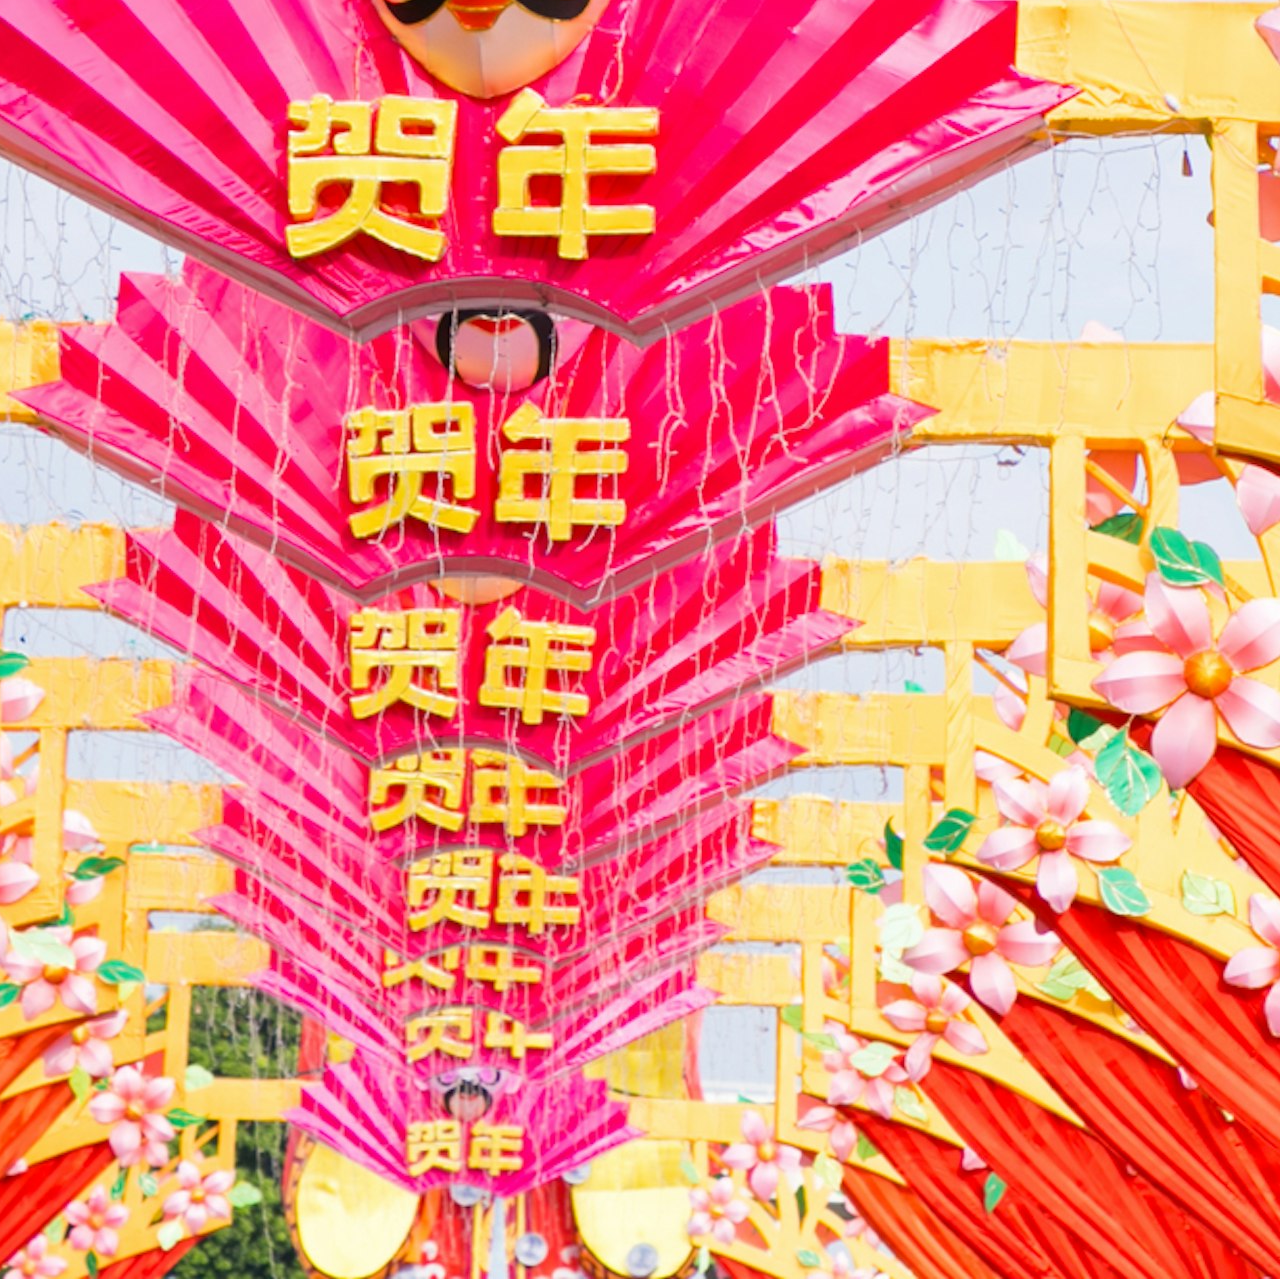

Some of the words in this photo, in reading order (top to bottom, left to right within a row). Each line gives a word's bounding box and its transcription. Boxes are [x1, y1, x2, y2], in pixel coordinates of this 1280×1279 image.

[285, 88, 660, 262] 贺年
[347, 401, 632, 541] 贺年
[349, 605, 595, 725] 贺年
[369, 748, 568, 836] 贺年
[407, 849, 581, 934] 贺年
[407, 1120, 524, 1176] 贺年
